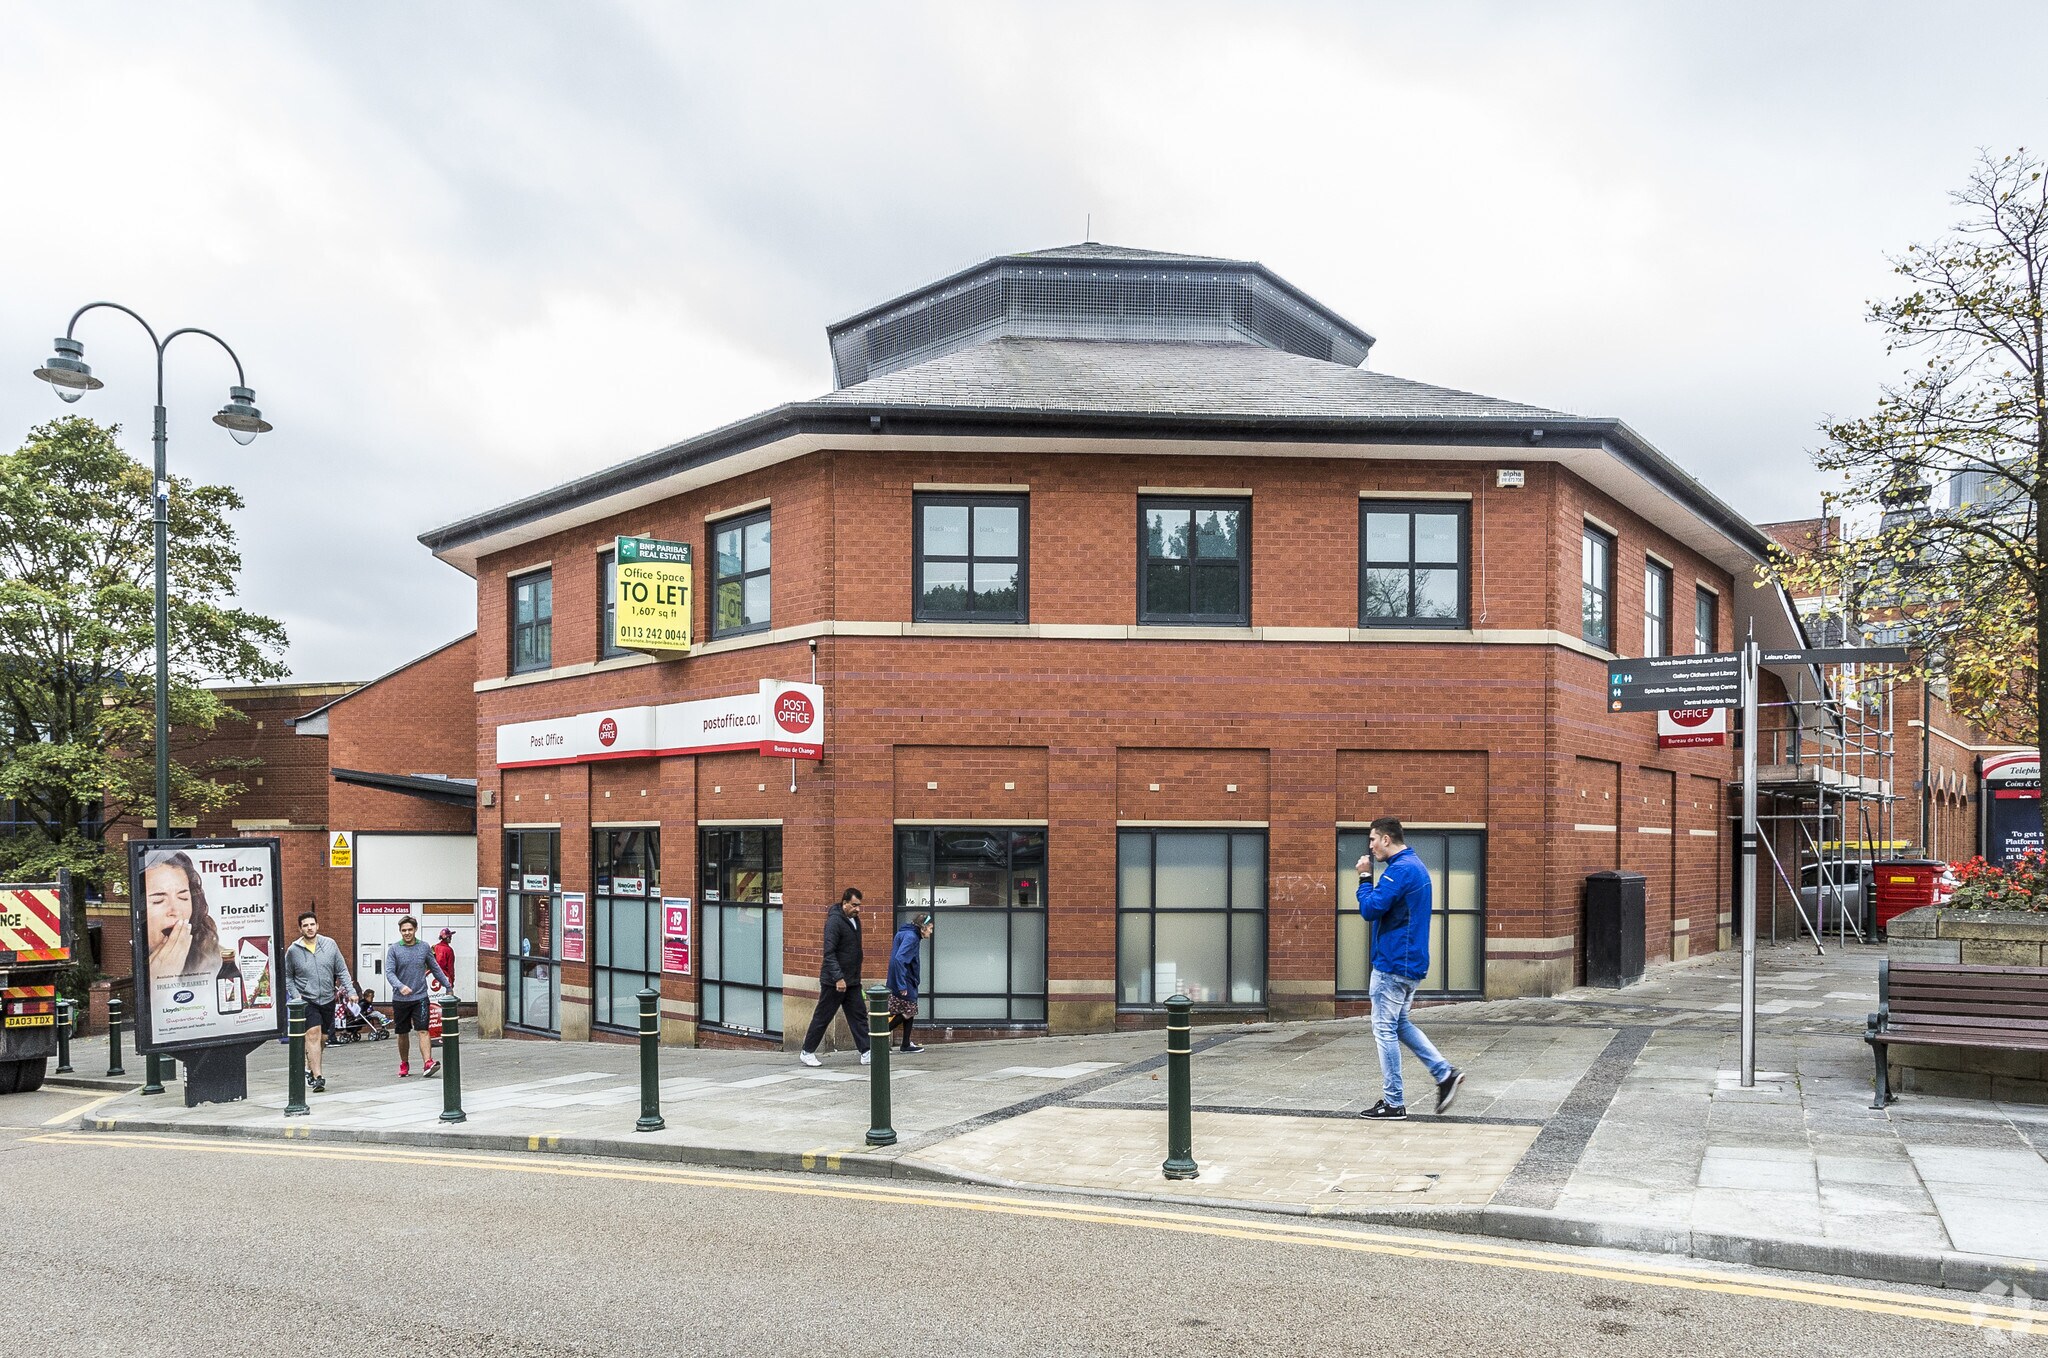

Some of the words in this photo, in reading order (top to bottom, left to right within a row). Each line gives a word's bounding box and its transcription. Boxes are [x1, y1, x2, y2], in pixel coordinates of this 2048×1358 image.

[639, 543, 655, 551] BNP
[657, 544, 688, 554] PARIBAS
[640, 551, 658, 559] REAL
[660, 552, 686, 561] ESTATE
[624, 568, 653, 579] Office
[656, 571, 685, 583] Space
[620, 581, 648, 603] TO
[656, 584, 689, 606] LET
[632, 606, 655, 617] 1,607
[671, 609, 677, 617] ft
[621, 626, 643, 638] 0113
[646, 628, 662, 640] 242
[665, 630, 687, 641] 0044
[782, 699, 806, 712] POST
[778, 710, 810, 724] OFFICE
[1672, 708, 1708, 719] OFFICE
[601, 722, 614, 732] POST
[600, 730, 615, 740] OFFICE
[1695, 736, 1714, 744] Change
[530, 735, 544, 748] Post
[545, 734, 563, 747] Office
[798, 747, 815, 755] Change
[2010, 766, 2040, 775] Telepho
[2024, 831, 2037, 839] get
[199, 859, 237, 873] Tired
[220, 873, 264, 888] Tired?
[0, 914, 21, 926] NCE
[162, 1005, 206, 1014] LloydsPharmacy
[9, 1018, 32, 1026] DA03
[34, 1016, 50, 1025] TDX
[166, 1015, 205, 1024] Superdrug
